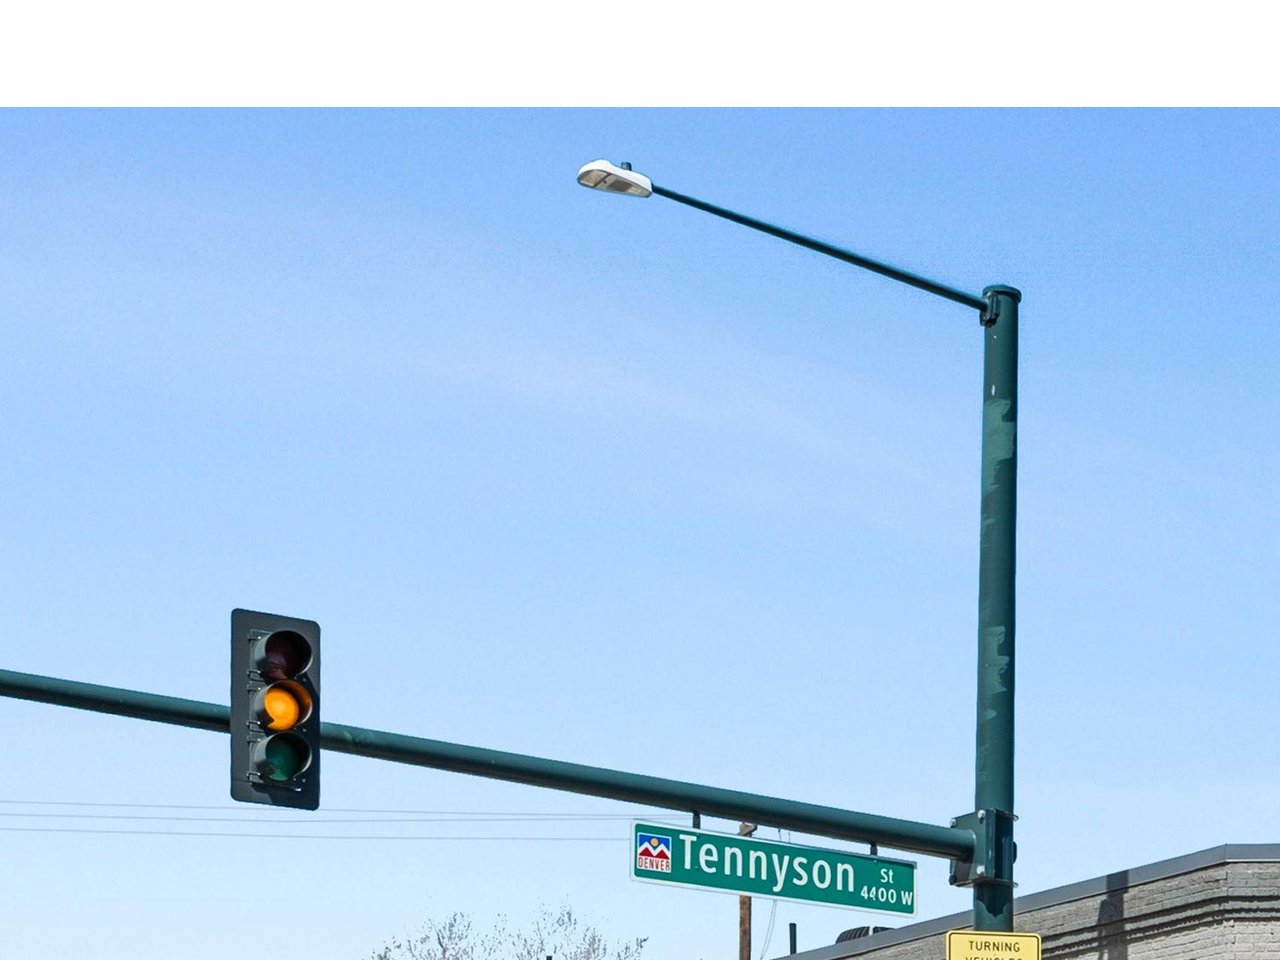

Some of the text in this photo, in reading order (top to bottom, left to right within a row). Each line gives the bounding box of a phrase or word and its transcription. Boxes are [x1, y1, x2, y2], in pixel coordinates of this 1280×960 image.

[637, 855, 671, 872] DENVER
[678, 834, 855, 892] Tennyson
[880, 868, 894, 884] St
[860, 885, 913, 905] 4400 W
[968, 940, 1021, 953] TURNING
